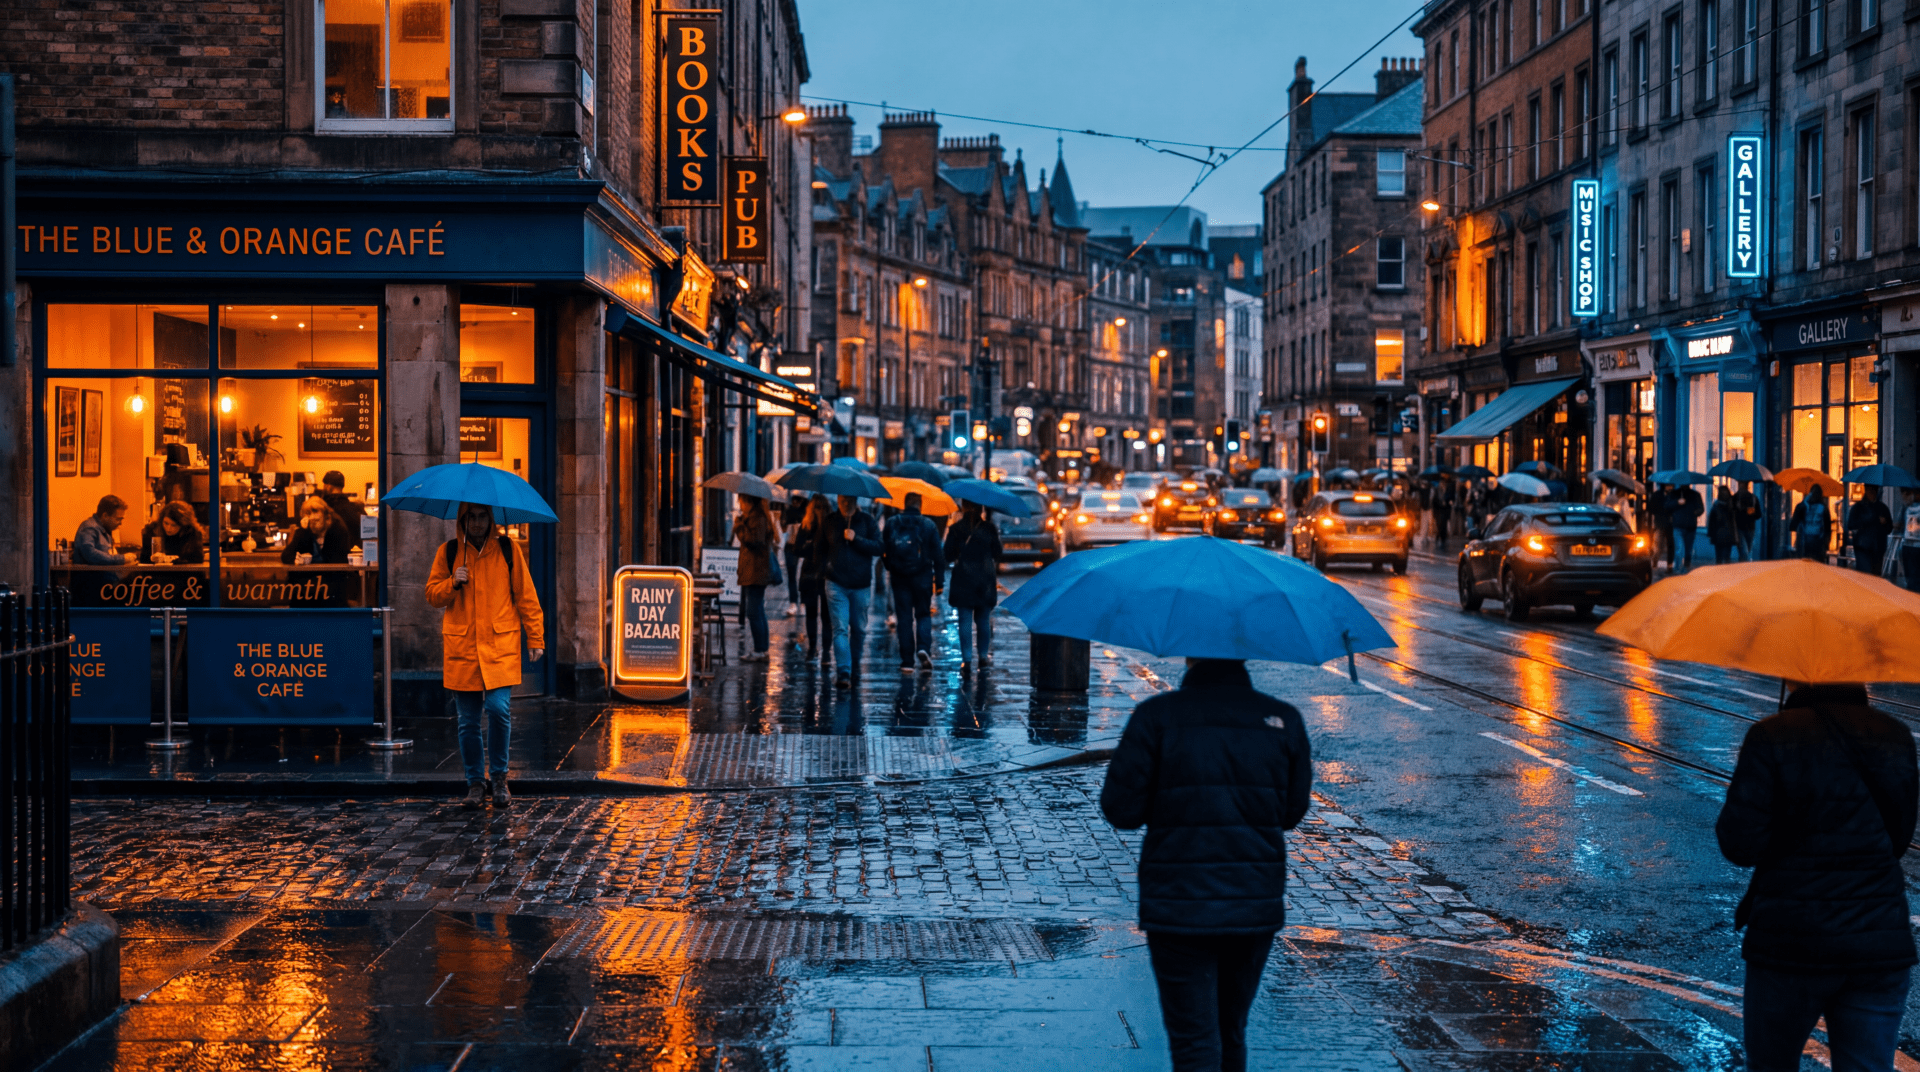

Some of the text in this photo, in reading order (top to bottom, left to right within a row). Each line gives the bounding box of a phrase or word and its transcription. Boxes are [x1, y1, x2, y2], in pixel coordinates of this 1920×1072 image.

[676, 27, 708, 192] BOOKS
[734, 170, 759, 249] PUB
[1737, 145, 1754, 268] GALLERY
[18, 221, 445, 256] THE BLUE & ORANGE CAFÉ
[1579, 186, 1594, 309] MUSIC SHOP
[1798, 317, 1848, 345] GALLERY
[101, 575, 330, 606] coffee & warmth
[631, 587, 674, 604] RAINY
[638, 605, 667, 622] DAY
[624, 622, 680, 639] BAZAAR
[69, 643, 101, 658] LUE
[237, 643, 324, 658] THE BLUE
[233, 663, 327, 677] & ORANGE
[257, 679, 304, 697] CAFÉ
